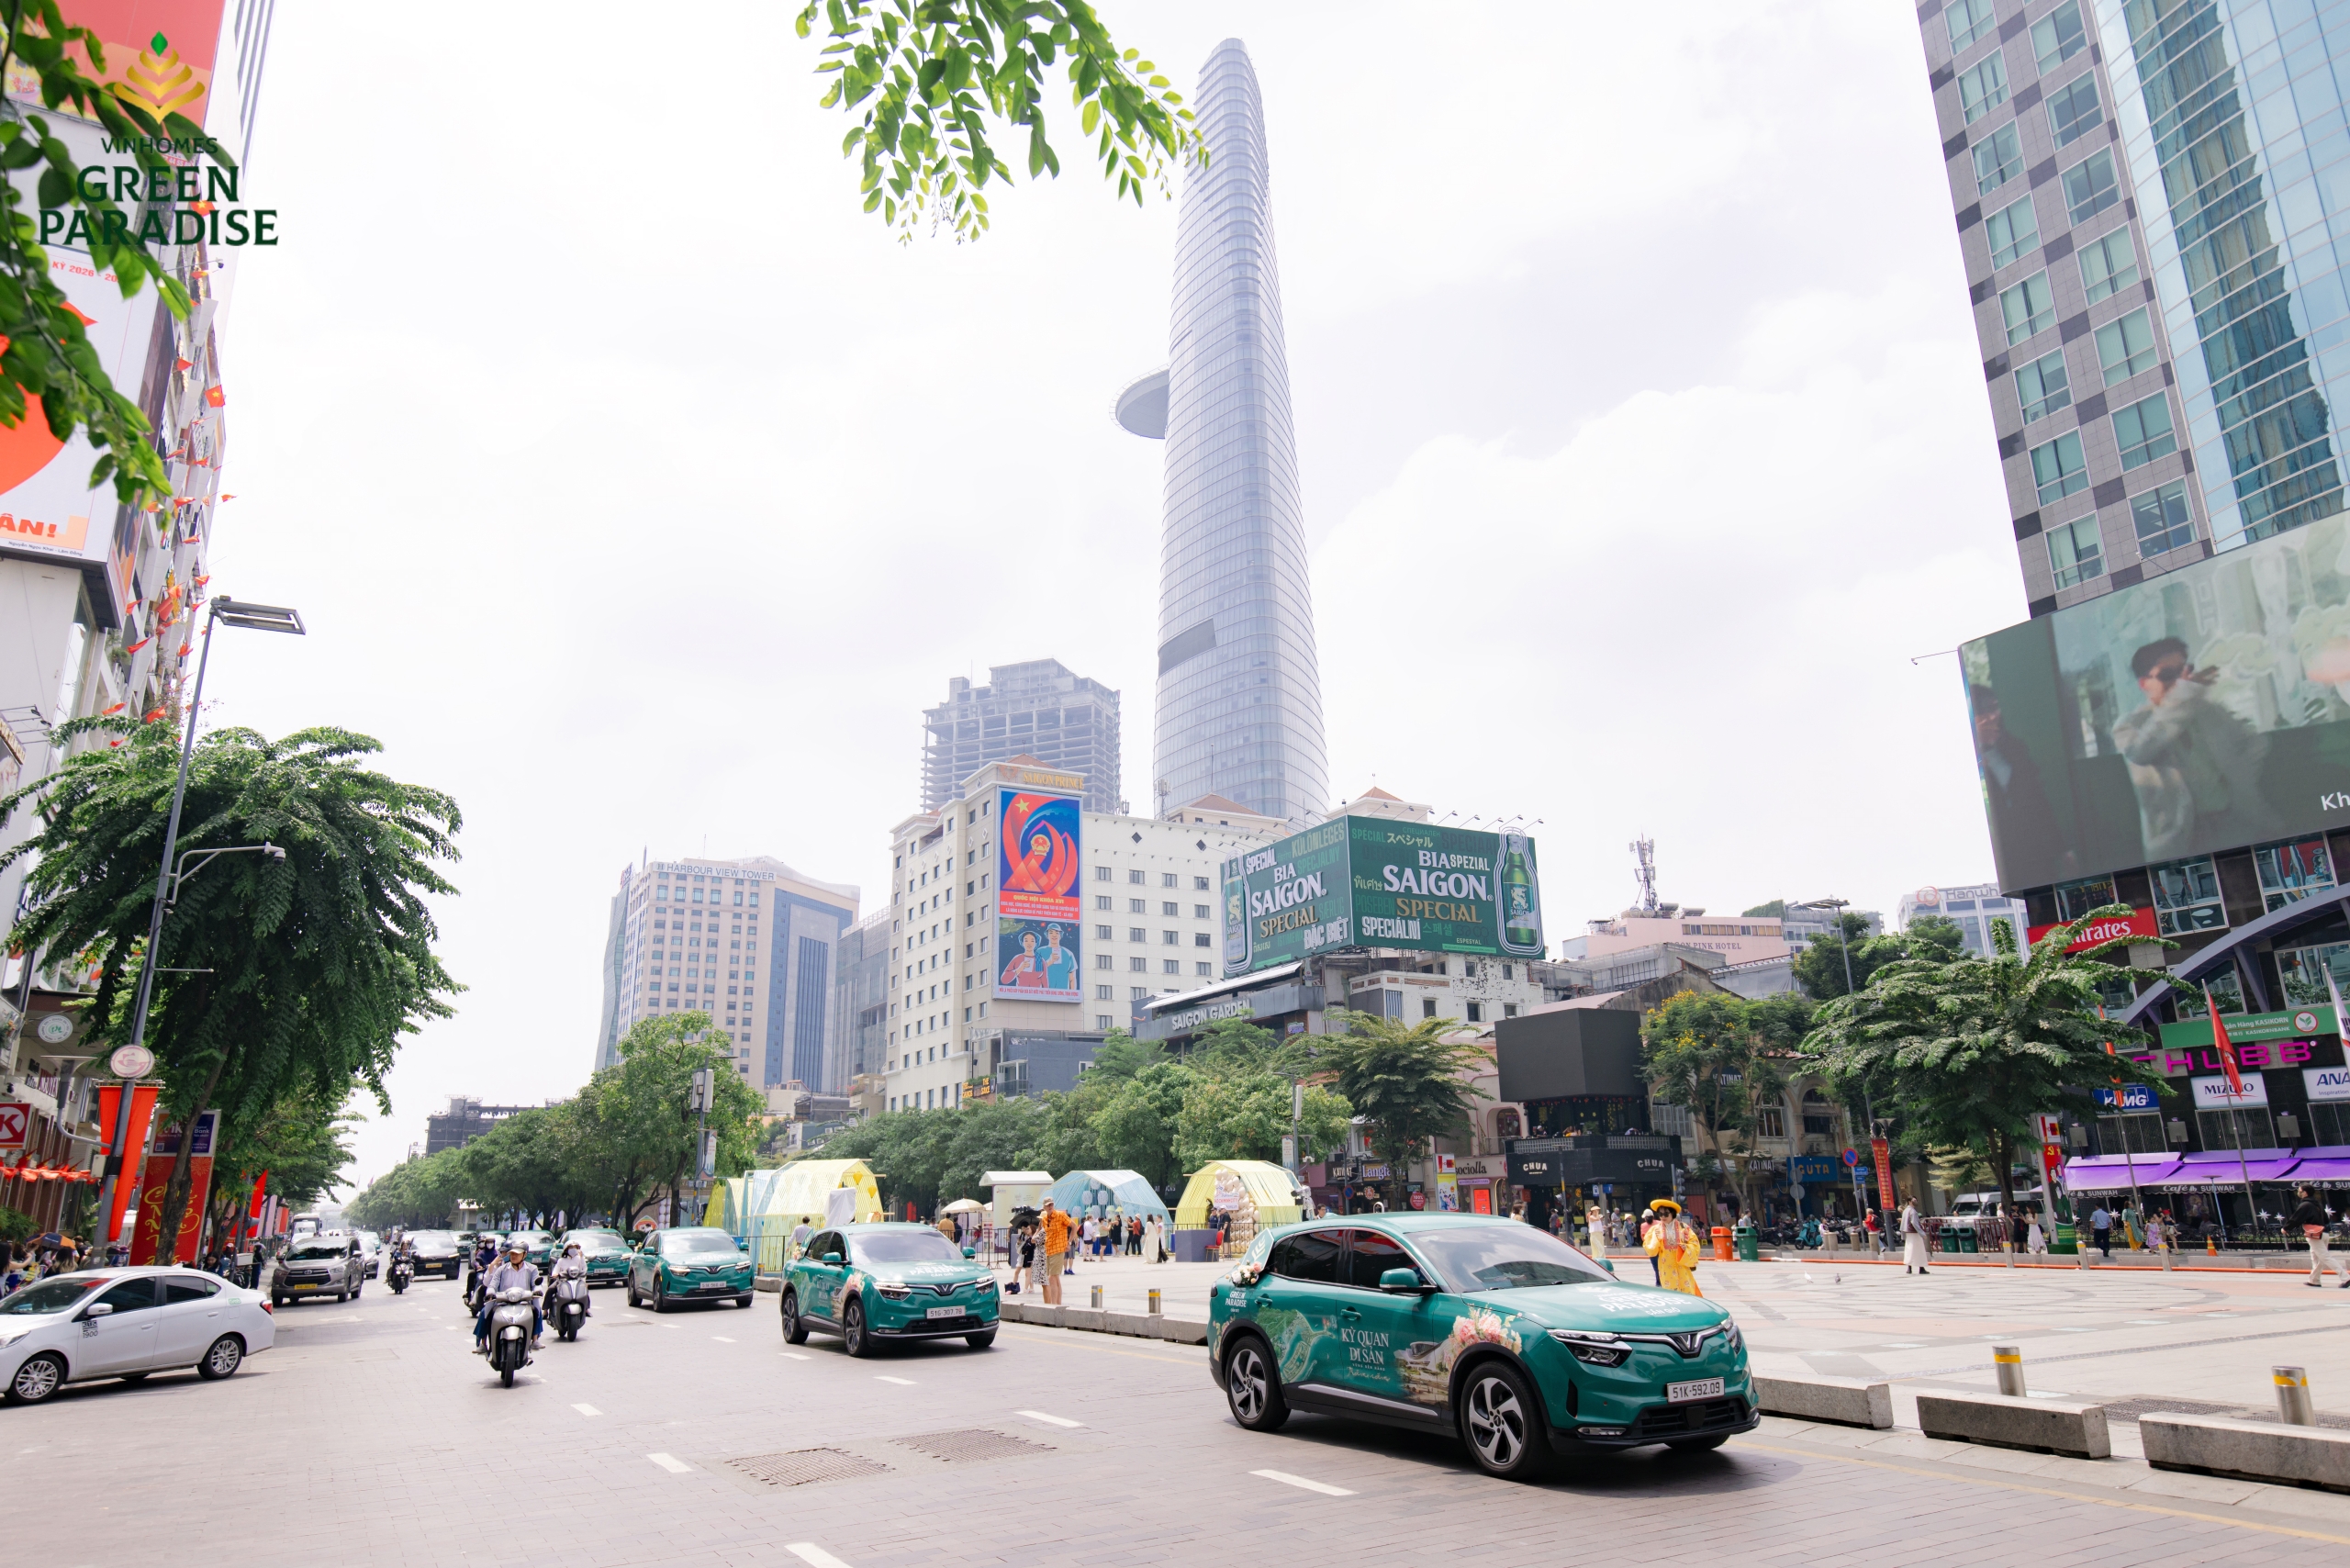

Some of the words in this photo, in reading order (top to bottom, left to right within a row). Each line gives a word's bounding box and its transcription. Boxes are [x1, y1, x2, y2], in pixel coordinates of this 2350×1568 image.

[51, 261, 66, 271] KỲ
[69, 264, 95, 277] 2026
[104, 273, 119, 283] 20
[1024, 771, 1054, 785] SAIGON
[1055, 775, 1084, 790] PRINCE
[1351, 827, 1386, 843] SPÉCIAL
[1403, 826, 1441, 837] СПЕЦИАЛЕН
[1292, 822, 1345, 858] KÜLÖNLEGES
[1386, 833, 1434, 848] スペシャル
[1297, 846, 1340, 875] SPECJALNY
[1417, 849, 1451, 869] BIA
[1449, 854, 1491, 871] SPEZIAL
[667, 863, 713, 876] HARBOUR
[715, 868, 739, 878] VIEW
[742, 870, 775, 880] TOWER
[1274, 862, 1297, 884] BIA
[1353, 875, 1383, 891] พิเศษ
[1382, 865, 1487, 902] SAIGON
[1251, 870, 1324, 918] SAIGON
[1945, 886, 2000, 900] Hanwh
[1355, 894, 1395, 915] POSEBEN
[1396, 897, 1483, 924] SPECIAL
[1259, 905, 1320, 939] SPECIAL
[1423, 922, 1453, 936] 스페셜
[2076, 921, 2132, 944] irates
[1456, 937, 1483, 946] ESPESYAL
[1693, 942, 1714, 950] PINK
[1715, 942, 1741, 950] HOTEL
[1171, 1008, 1207, 1031] SAIGON
[1210, 998, 1251, 1020] GARDEN
[2255, 1016, 2288, 1026] KASIKORN
[2245, 1026, 2290, 1036] KASIKORNBANK
[2317, 1071, 2350, 1086] ANA
[2204, 1082, 2255, 1094] MIZUO
[2318, 1089, 2350, 1097] Inspiration
[2103, 1093, 2147, 1106] KMG
[1522, 1161, 1548, 1171] CHUA
[1638, 1159, 1665, 1168] CHUA
[1749, 1159, 1775, 1172] KATINAT
[1796, 1164, 1830, 1175] GUTA
[2087, 1189, 2119, 1197] SUNWAH
[2163, 1184, 2188, 1193] Café
[2200, 1184, 2235, 1193] SUNWAH
[1225, 1297, 1248, 1308] PARADISE
[1230, 1291, 1247, 1299] GREEN
[1598, 1296, 1693, 1313] PARADISE
[83, 1330, 98, 1338] 1900
[1341, 1327, 1357, 1343] KỲ
[1357, 1330, 1390, 1348] QUAN
[1349, 1347, 1362, 1362] DI
[1362, 1345, 1384, 1365] SẢN
[1673, 1382, 1721, 1399] 51K-592.09
